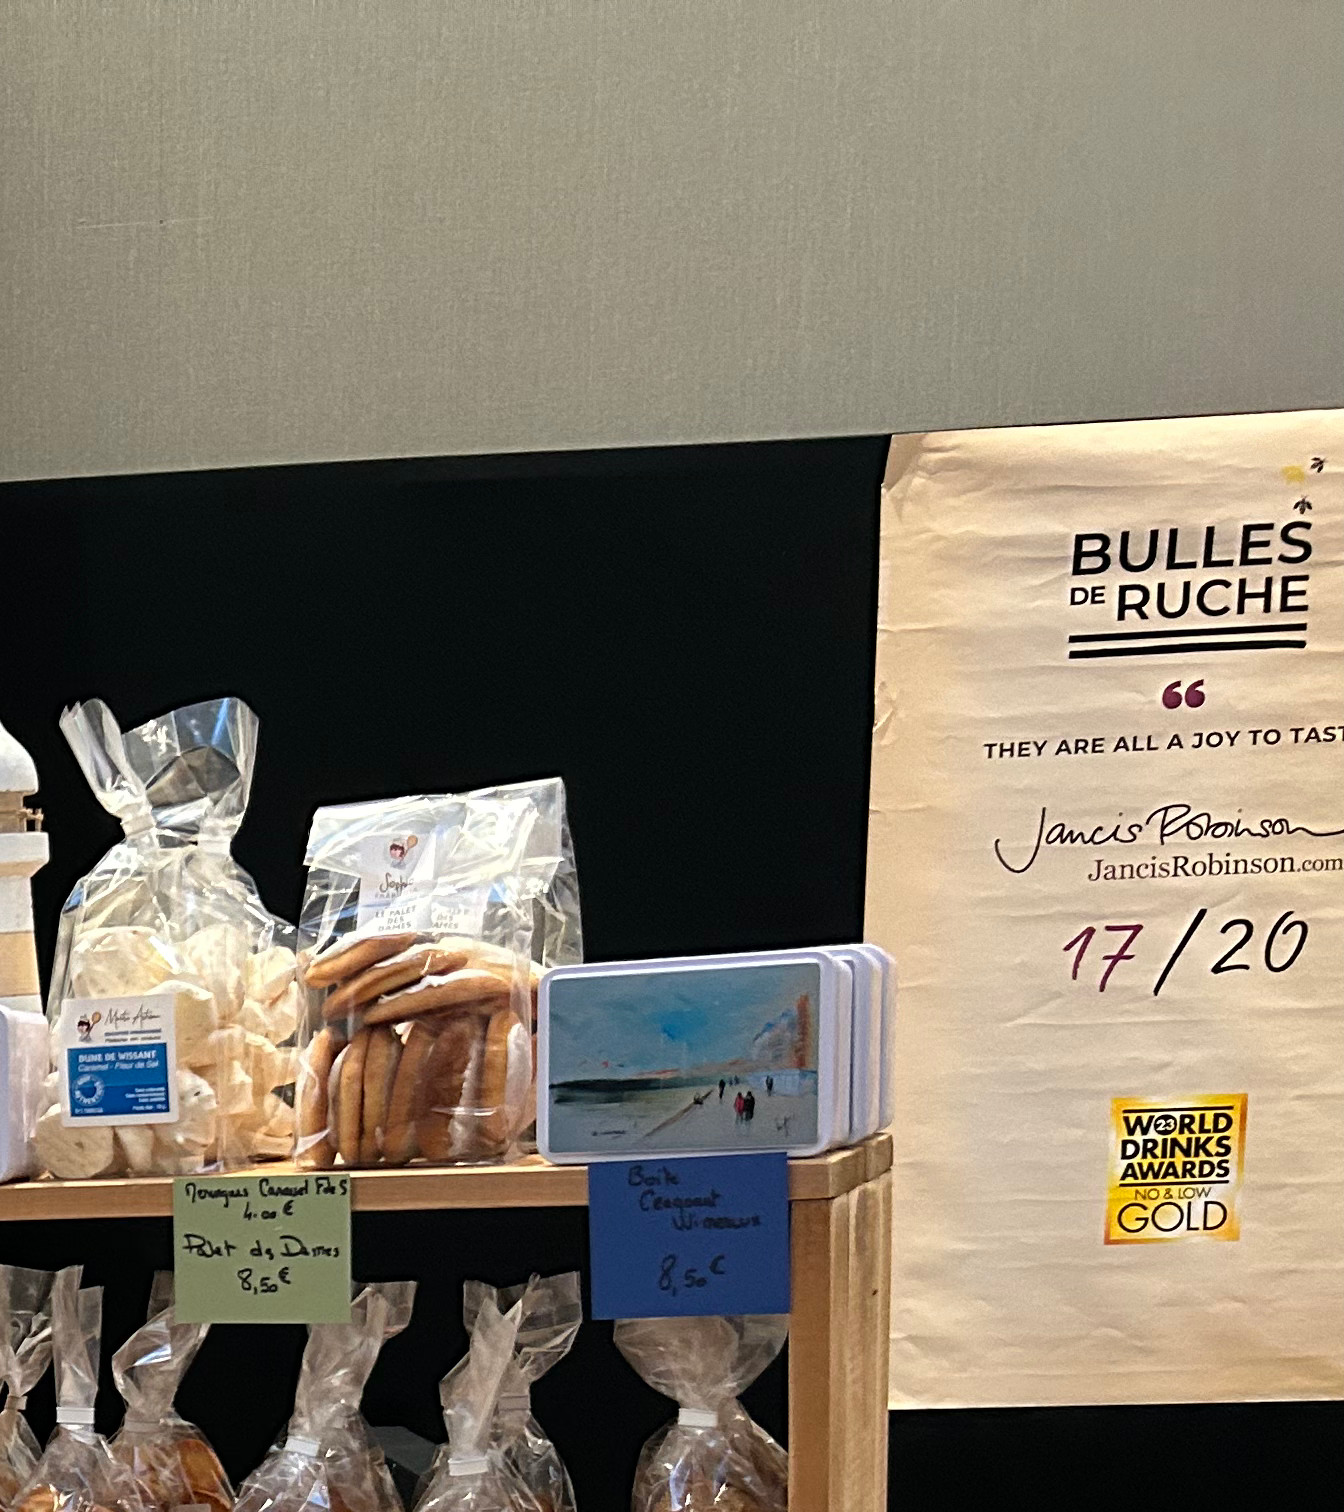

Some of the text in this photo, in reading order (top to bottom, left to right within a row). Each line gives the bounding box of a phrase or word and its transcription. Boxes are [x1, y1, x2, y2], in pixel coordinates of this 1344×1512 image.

[1070, 520, 1314, 577] BULLES
[1069, 574, 1311, 622] DE RUCHE
[983, 724, 1344, 760] THEY ARE ALL A JOY TO TAST
[1087, 851, 1344, 883] JancisRobinson.com
[117, 1049, 158, 1062] WISSANT
[1120, 1135, 1233, 1161] DRINKS
[1119, 1159, 1231, 1182] AWARDS
[1134, 1187, 1162, 1201] NO
[1178, 1186, 1212, 1200] LOW
[1116, 1200, 1229, 1234] GOLD
